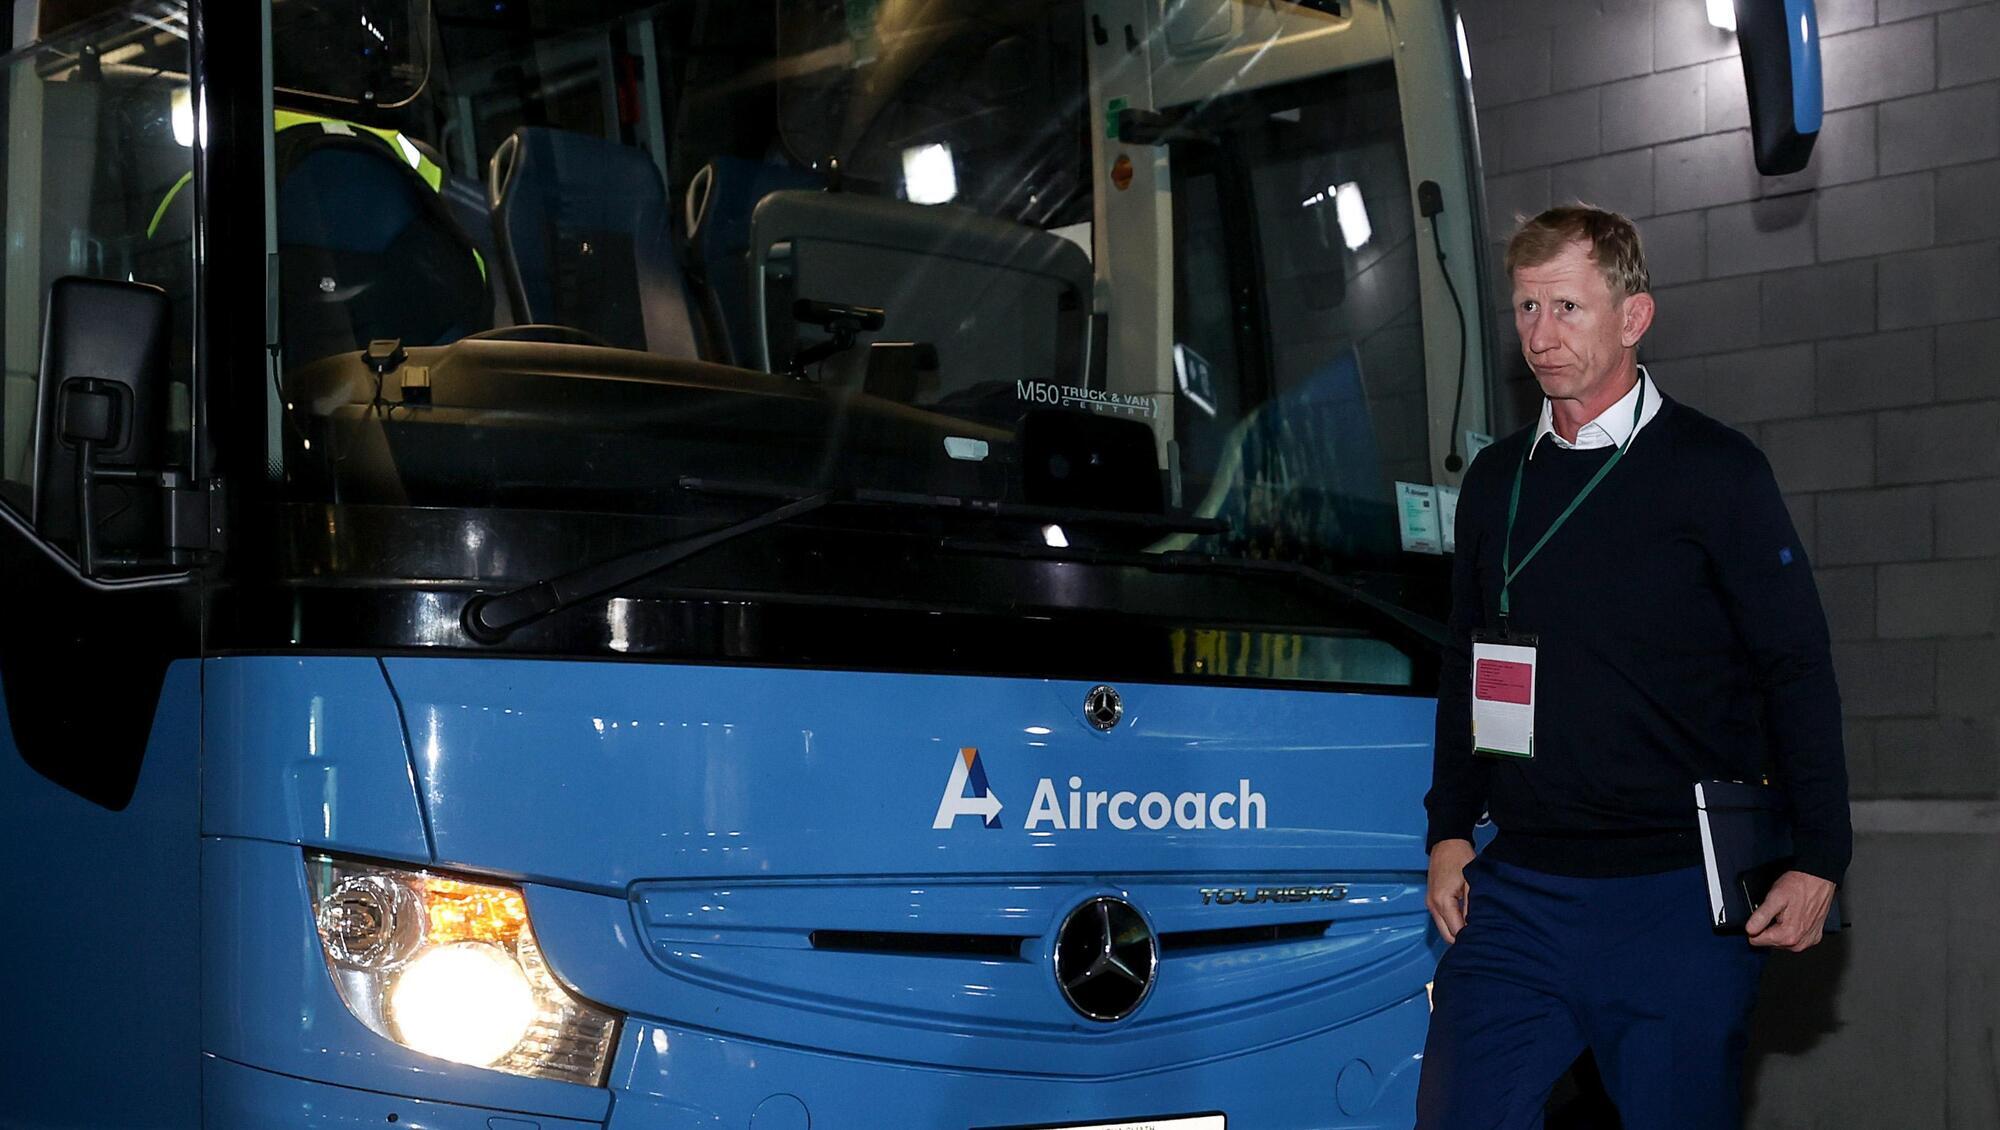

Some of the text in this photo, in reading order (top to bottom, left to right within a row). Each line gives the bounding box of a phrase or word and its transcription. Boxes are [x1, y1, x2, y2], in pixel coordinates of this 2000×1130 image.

[1017, 379, 1149, 406] M50 TRUCK & VAN
[1063, 399, 1150, 417] CENTRE
[1024, 776, 1266, 830] Aircoach
[1200, 886, 1348, 905] TOURISMO
